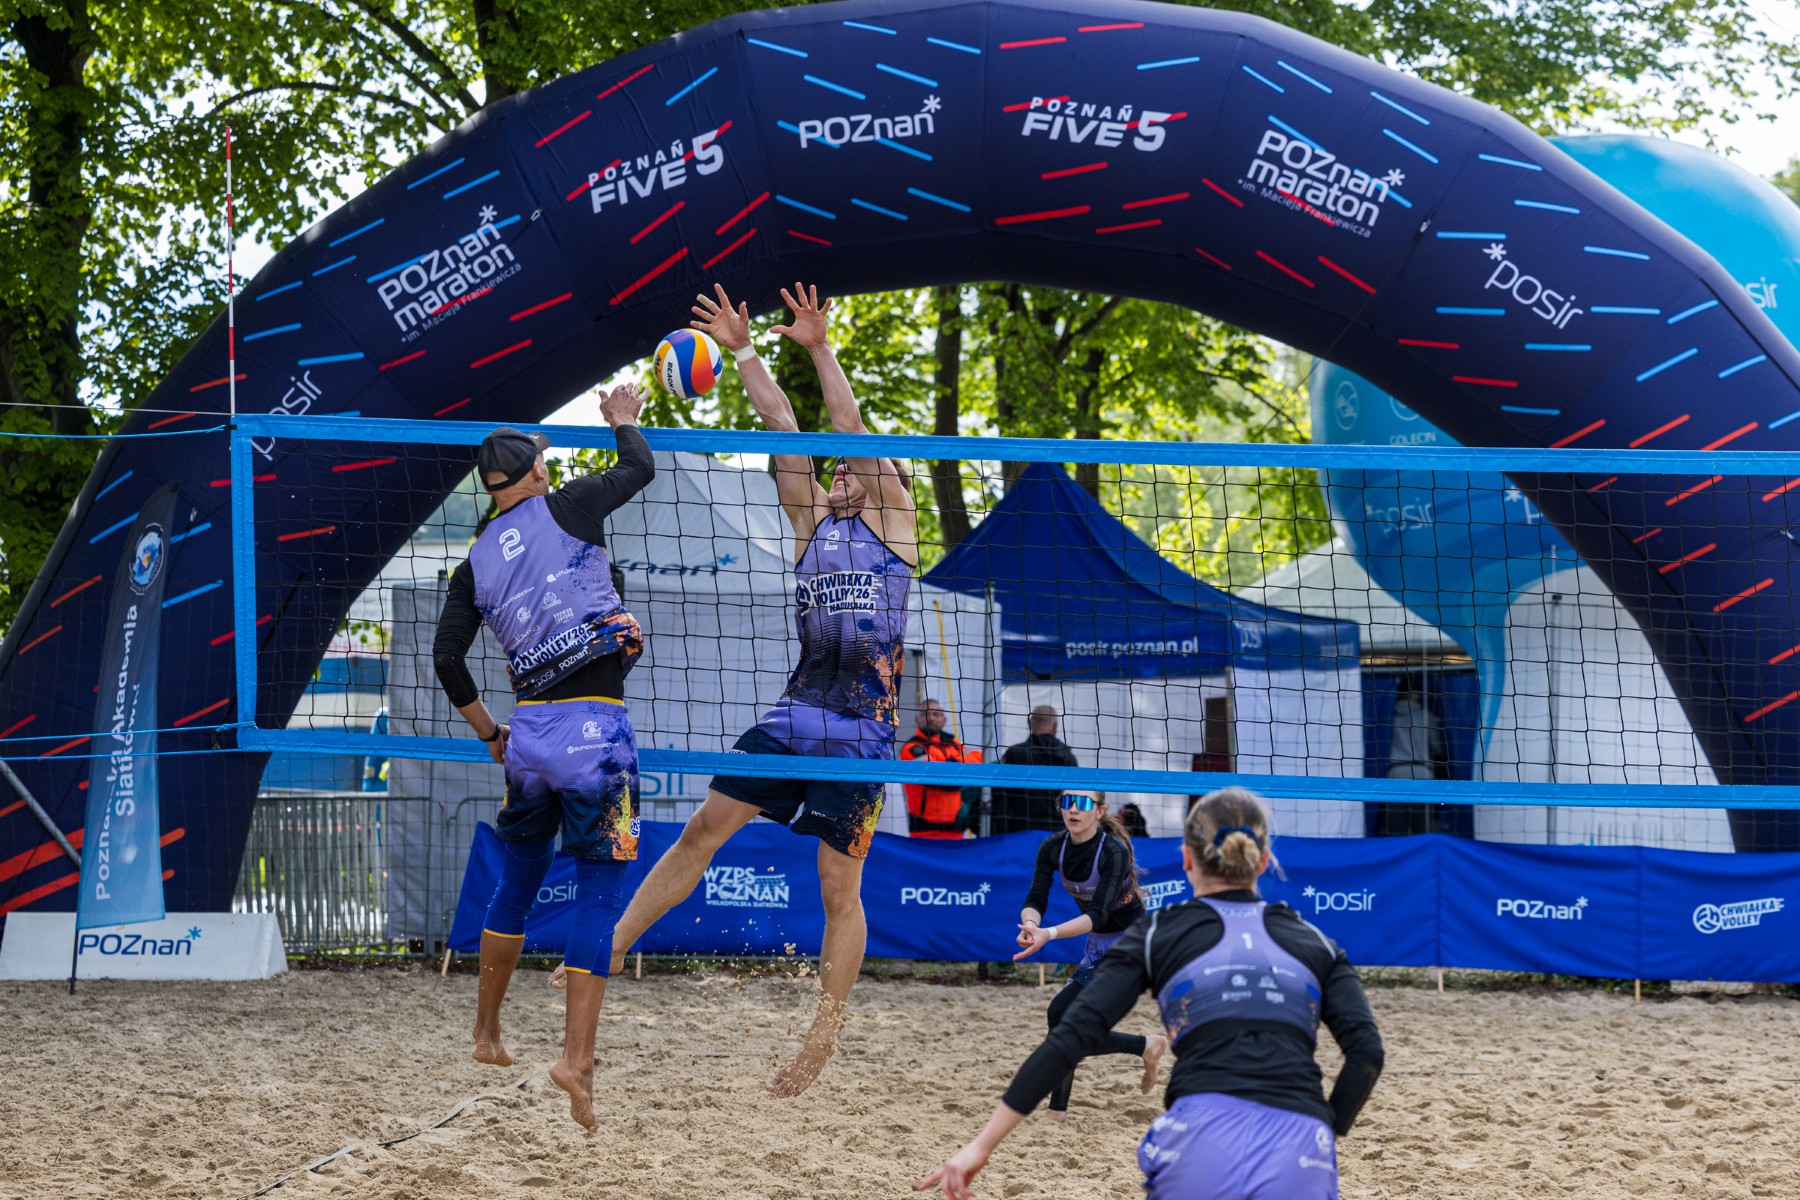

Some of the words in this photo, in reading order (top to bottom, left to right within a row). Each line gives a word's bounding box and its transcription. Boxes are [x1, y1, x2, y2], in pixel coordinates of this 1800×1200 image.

[1030, 96, 1133, 121] POZNAŃ
[1021, 112, 1127, 148] FIVE
[1133, 110, 1172, 152] 5
[588, 139, 685, 187] POZNAŃ
[590, 159, 688, 214] FIVE
[692, 130, 724, 176] 5
[1246, 158, 1380, 227] maraton
[1260, 187, 1302, 212] Macieja
[1304, 204, 1372, 239] Frankiewicza
[394, 243, 515, 332] maraton
[422, 304, 461, 331] Macieja
[461, 263, 521, 306] Frankiewicza
[1484, 259, 1584, 330] posir
[1740, 277, 1777, 309] sir
[499, 528, 526, 562] 2
[823, 529, 840, 551] 2
[810, 573, 874, 593] CHWIAŁKA
[703, 866, 756, 885] WZPS
[537, 880, 578, 904] osir
[1315, 888, 1376, 914] posir
[1721, 900, 1775, 916] CHWIAŁKA
[1722, 914, 1758, 928] VOLLEY
[1242, 932, 1253, 950] 1
